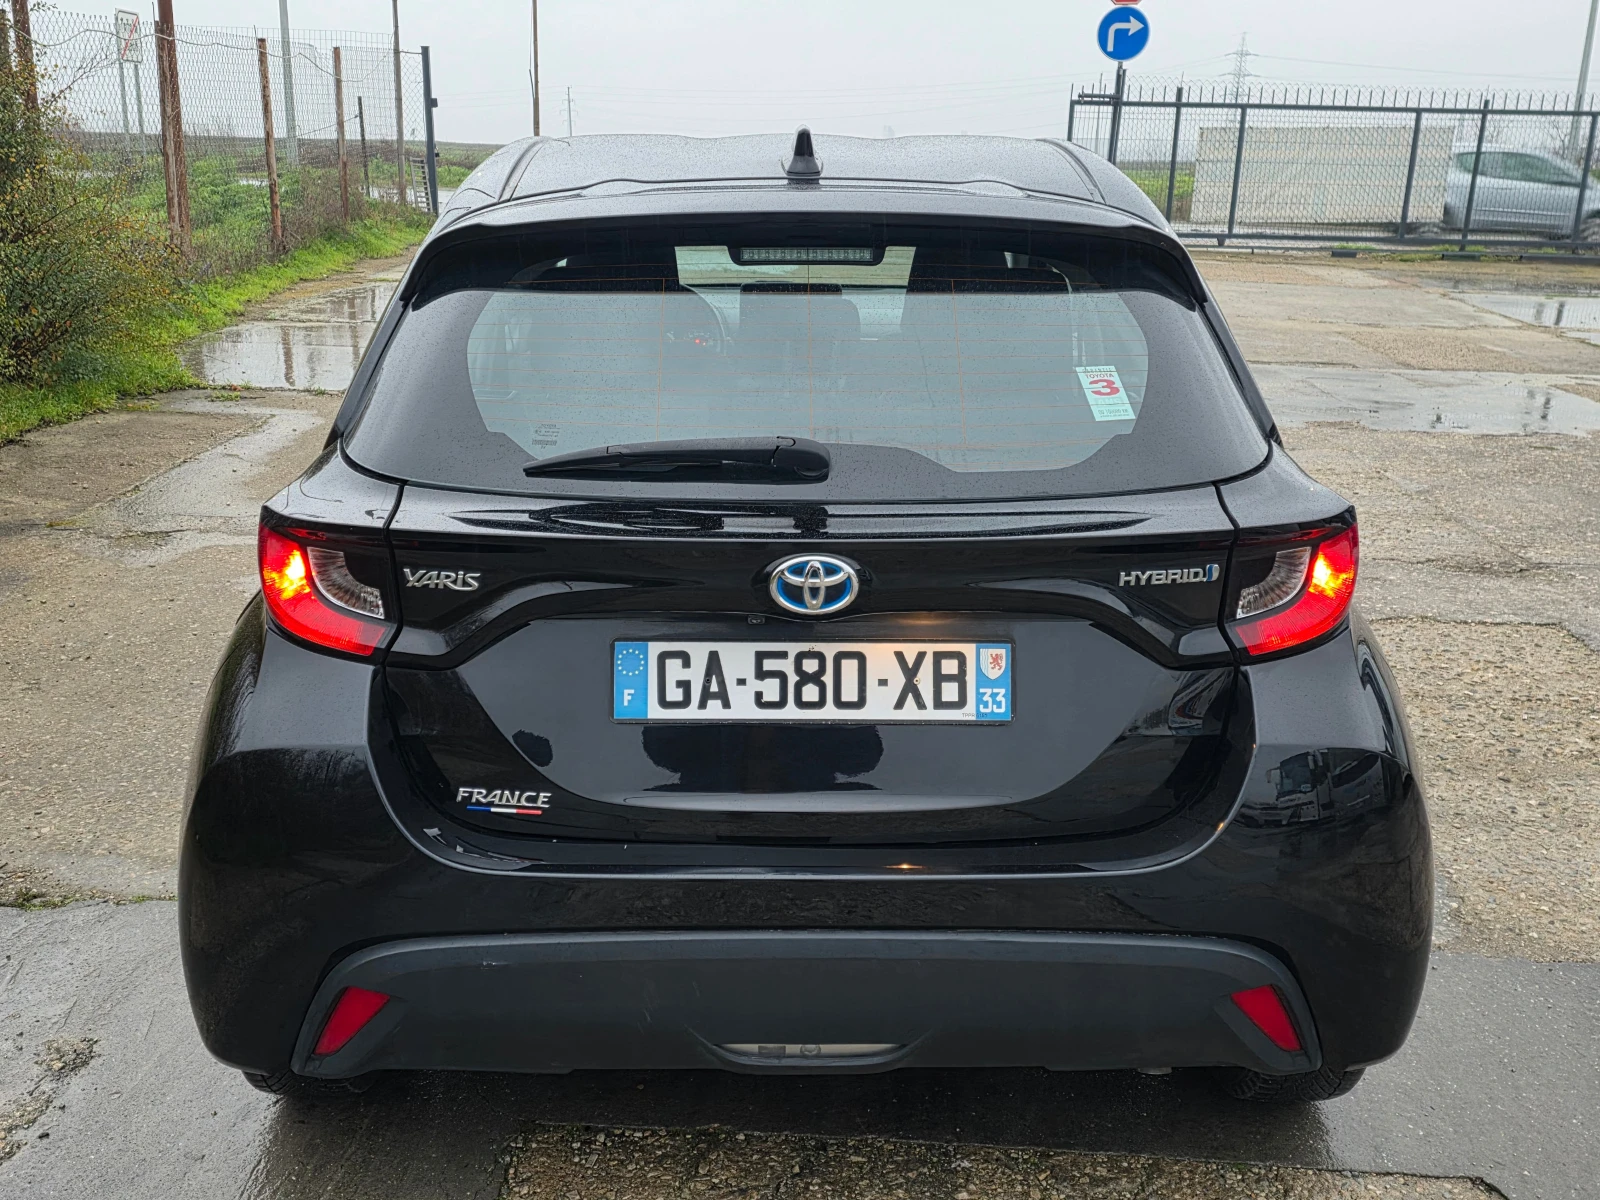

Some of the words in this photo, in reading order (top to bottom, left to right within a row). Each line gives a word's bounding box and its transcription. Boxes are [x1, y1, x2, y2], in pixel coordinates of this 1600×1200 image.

[1089, 379, 1120, 396] 3
[1118, 568, 1205, 587] HYBRID
[656, 650, 968, 711] GA-580-XB
[623, 689, 635, 706] F
[979, 688, 1006, 713] 33
[456, 788, 552, 808] FRANCE
